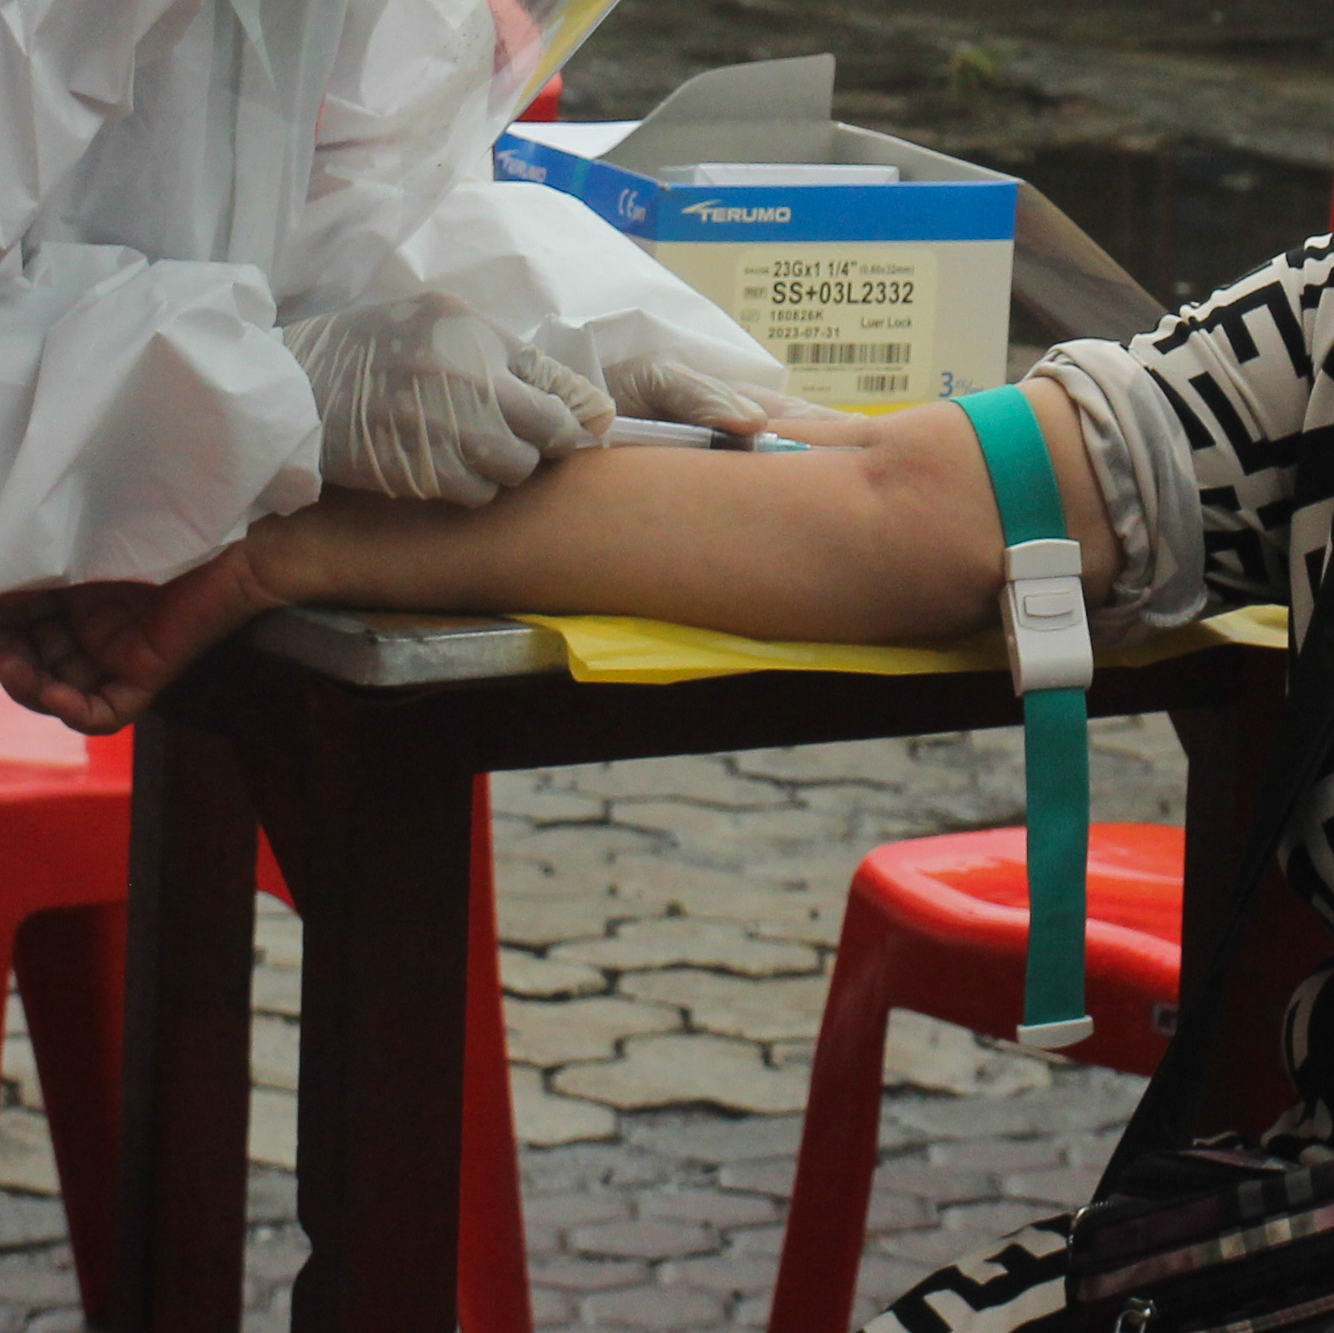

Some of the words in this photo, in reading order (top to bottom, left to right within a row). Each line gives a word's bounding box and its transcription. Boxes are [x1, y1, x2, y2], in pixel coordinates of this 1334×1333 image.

[695, 203, 792, 223] TERUMO
[773, 261, 820, 277] 23Gx1
[772, 281, 914, 304] SS+03L2332
[861, 316, 885, 328] Luer
[887, 316, 912, 328] Lock
[768, 327, 840, 339] 2023-07-31
[938, 371, 954, 398] 3
